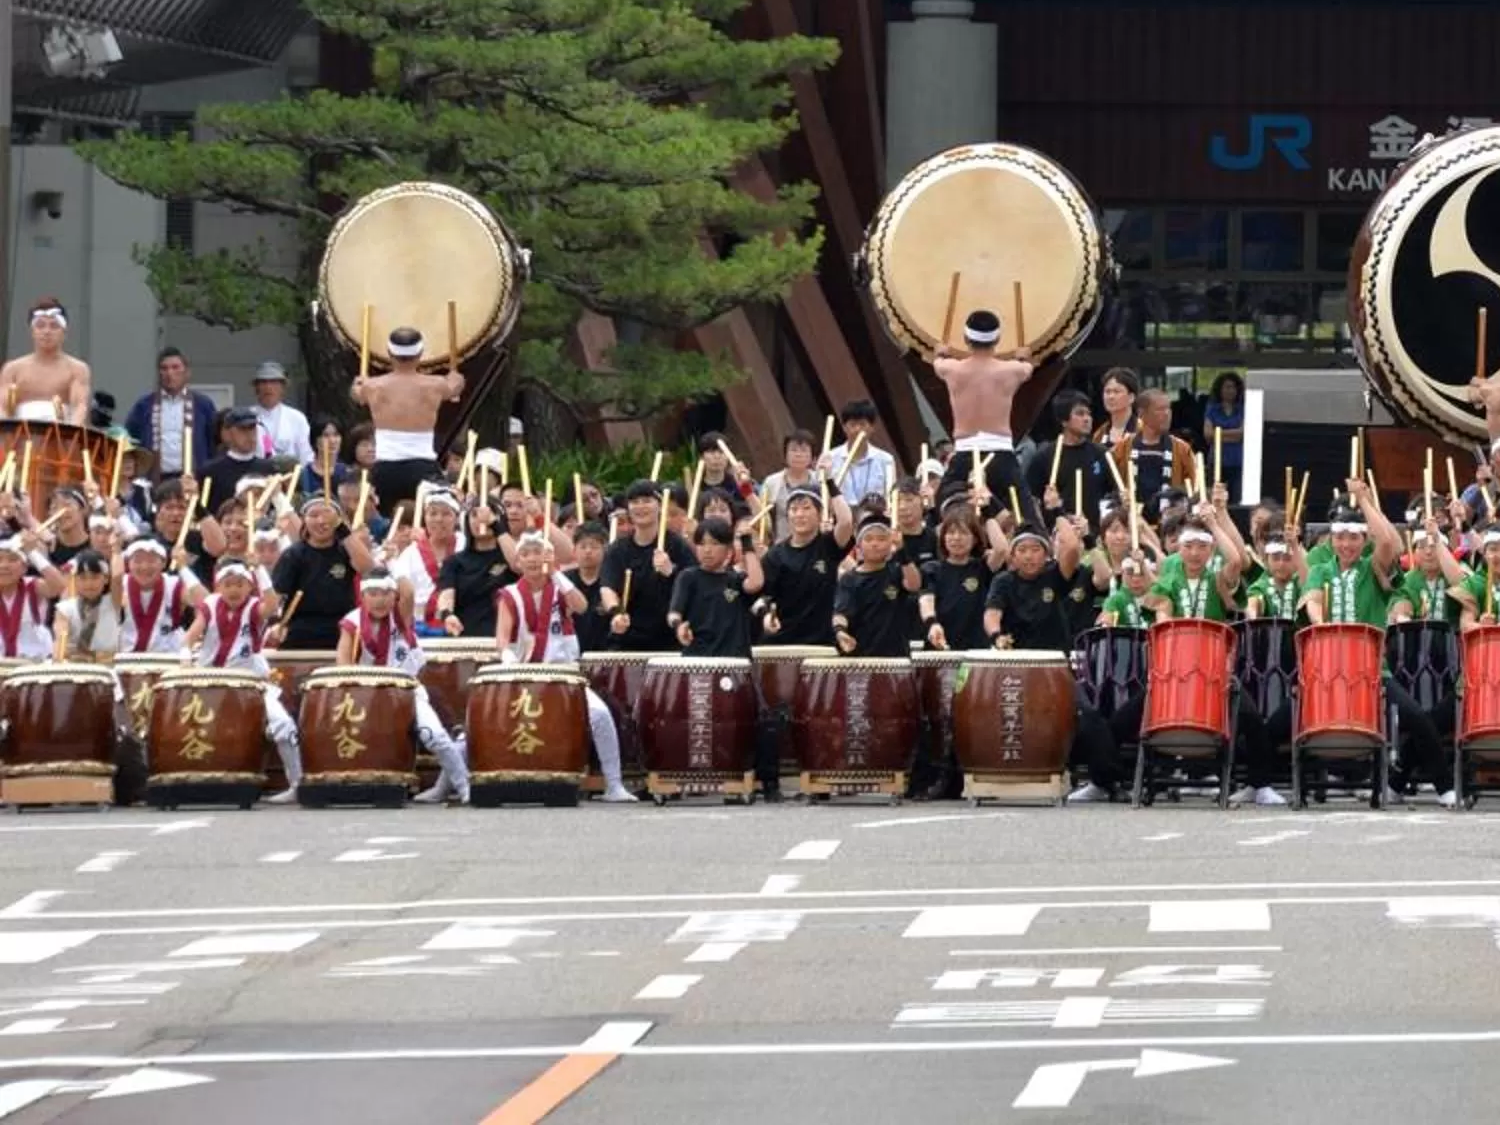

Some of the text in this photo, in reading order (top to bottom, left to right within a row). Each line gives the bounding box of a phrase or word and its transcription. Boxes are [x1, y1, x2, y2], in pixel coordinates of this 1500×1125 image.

[1211, 114, 1313, 170] JR
[178, 693, 216, 759] 九谷
[331, 692, 367, 759] 九谷
[507, 688, 545, 754] 九谷
